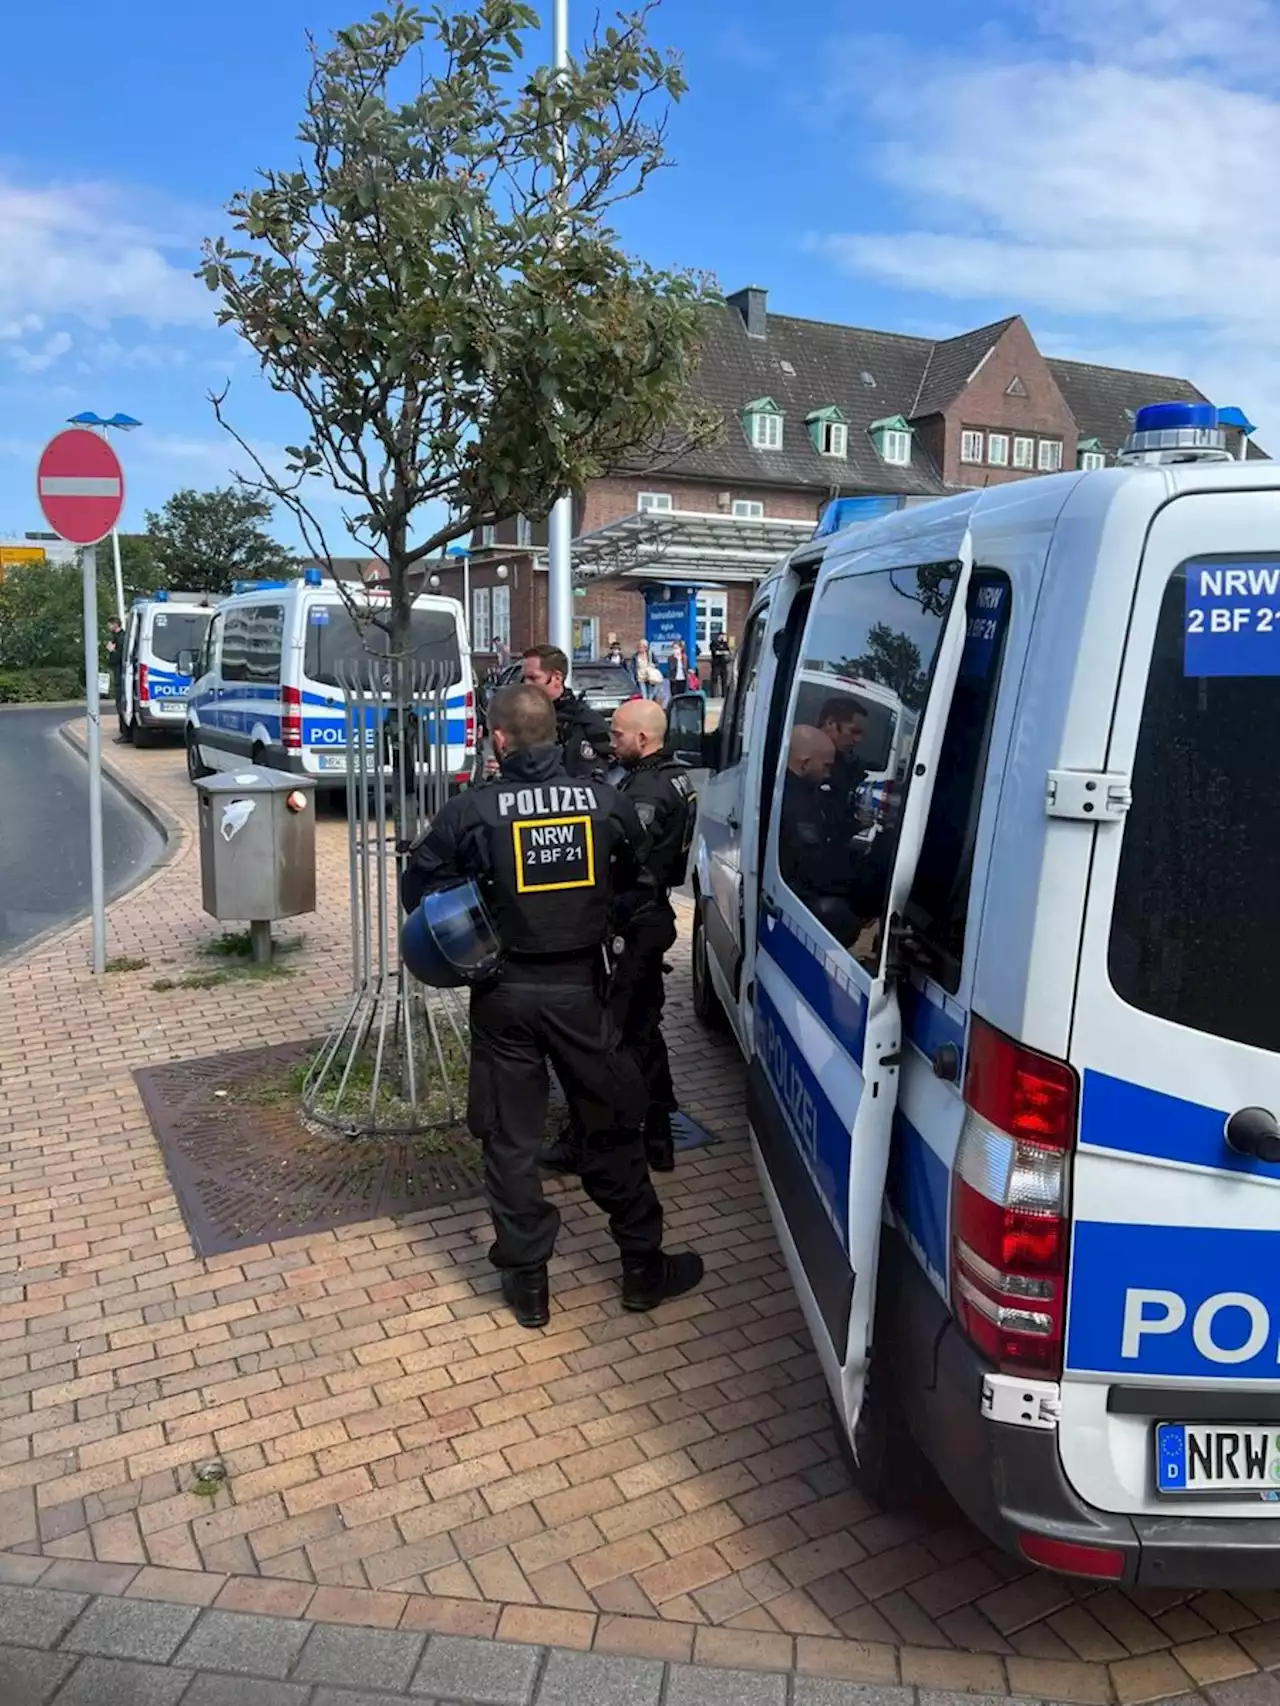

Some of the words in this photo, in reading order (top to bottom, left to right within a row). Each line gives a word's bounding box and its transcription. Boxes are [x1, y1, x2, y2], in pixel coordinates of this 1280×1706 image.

[1200, 569, 1280, 596] NRW
[977, 587, 1003, 609] NRW
[1187, 608, 1204, 633] 2
[1211, 608, 1251, 632] BF
[154, 685, 190, 695] POLIZ
[310, 728, 374, 743] POLZE
[499, 786, 597, 816] POLIZEI
[530, 825, 574, 846] NRW
[526, 850, 536, 865] 2
[541, 848, 561, 863] BF
[565, 845, 582, 862] 21
[768, 1015, 818, 1164] POLIZEI
[1121, 1288, 1280, 1364] PO
[1167, 1463, 1179, 1479] D
[1188, 1432, 1269, 1480] NRW
